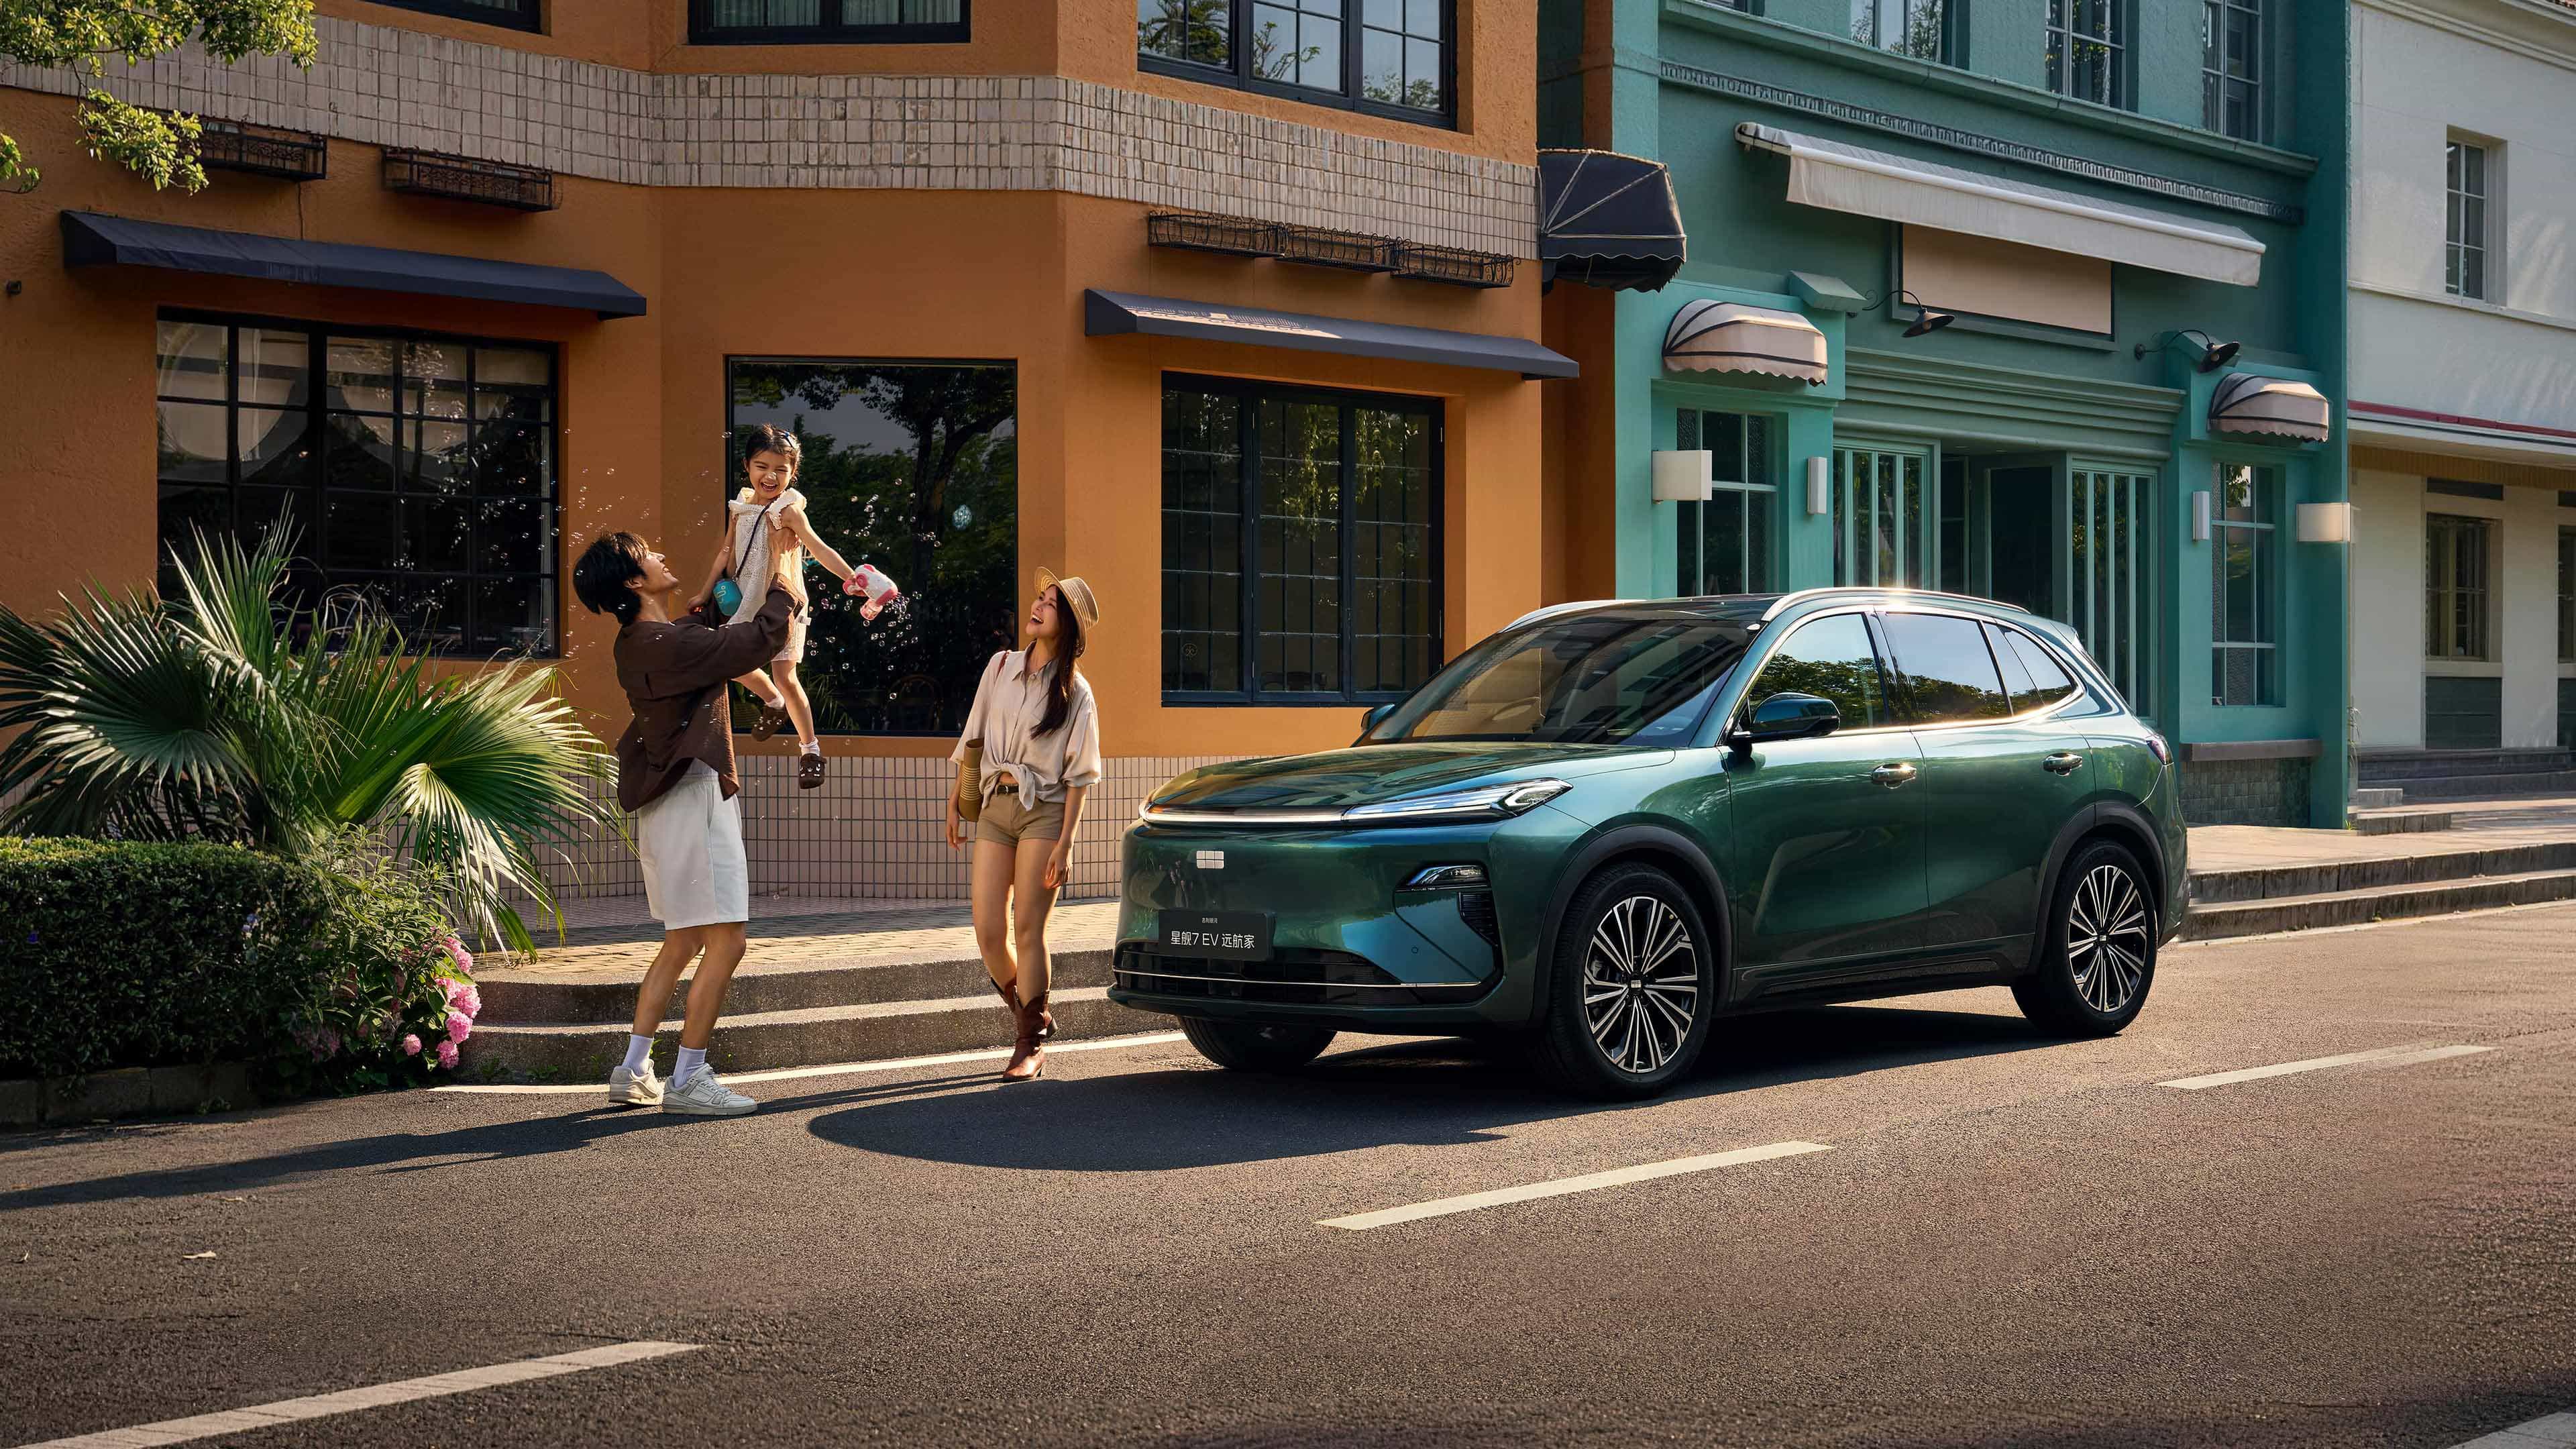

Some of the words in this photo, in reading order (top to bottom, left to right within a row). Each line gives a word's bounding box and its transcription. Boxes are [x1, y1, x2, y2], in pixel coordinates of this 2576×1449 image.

[1171, 931, 1199, 946] 星舰7
[1202, 933, 1219, 947] EV
[1222, 934, 1255, 949] 远航家
